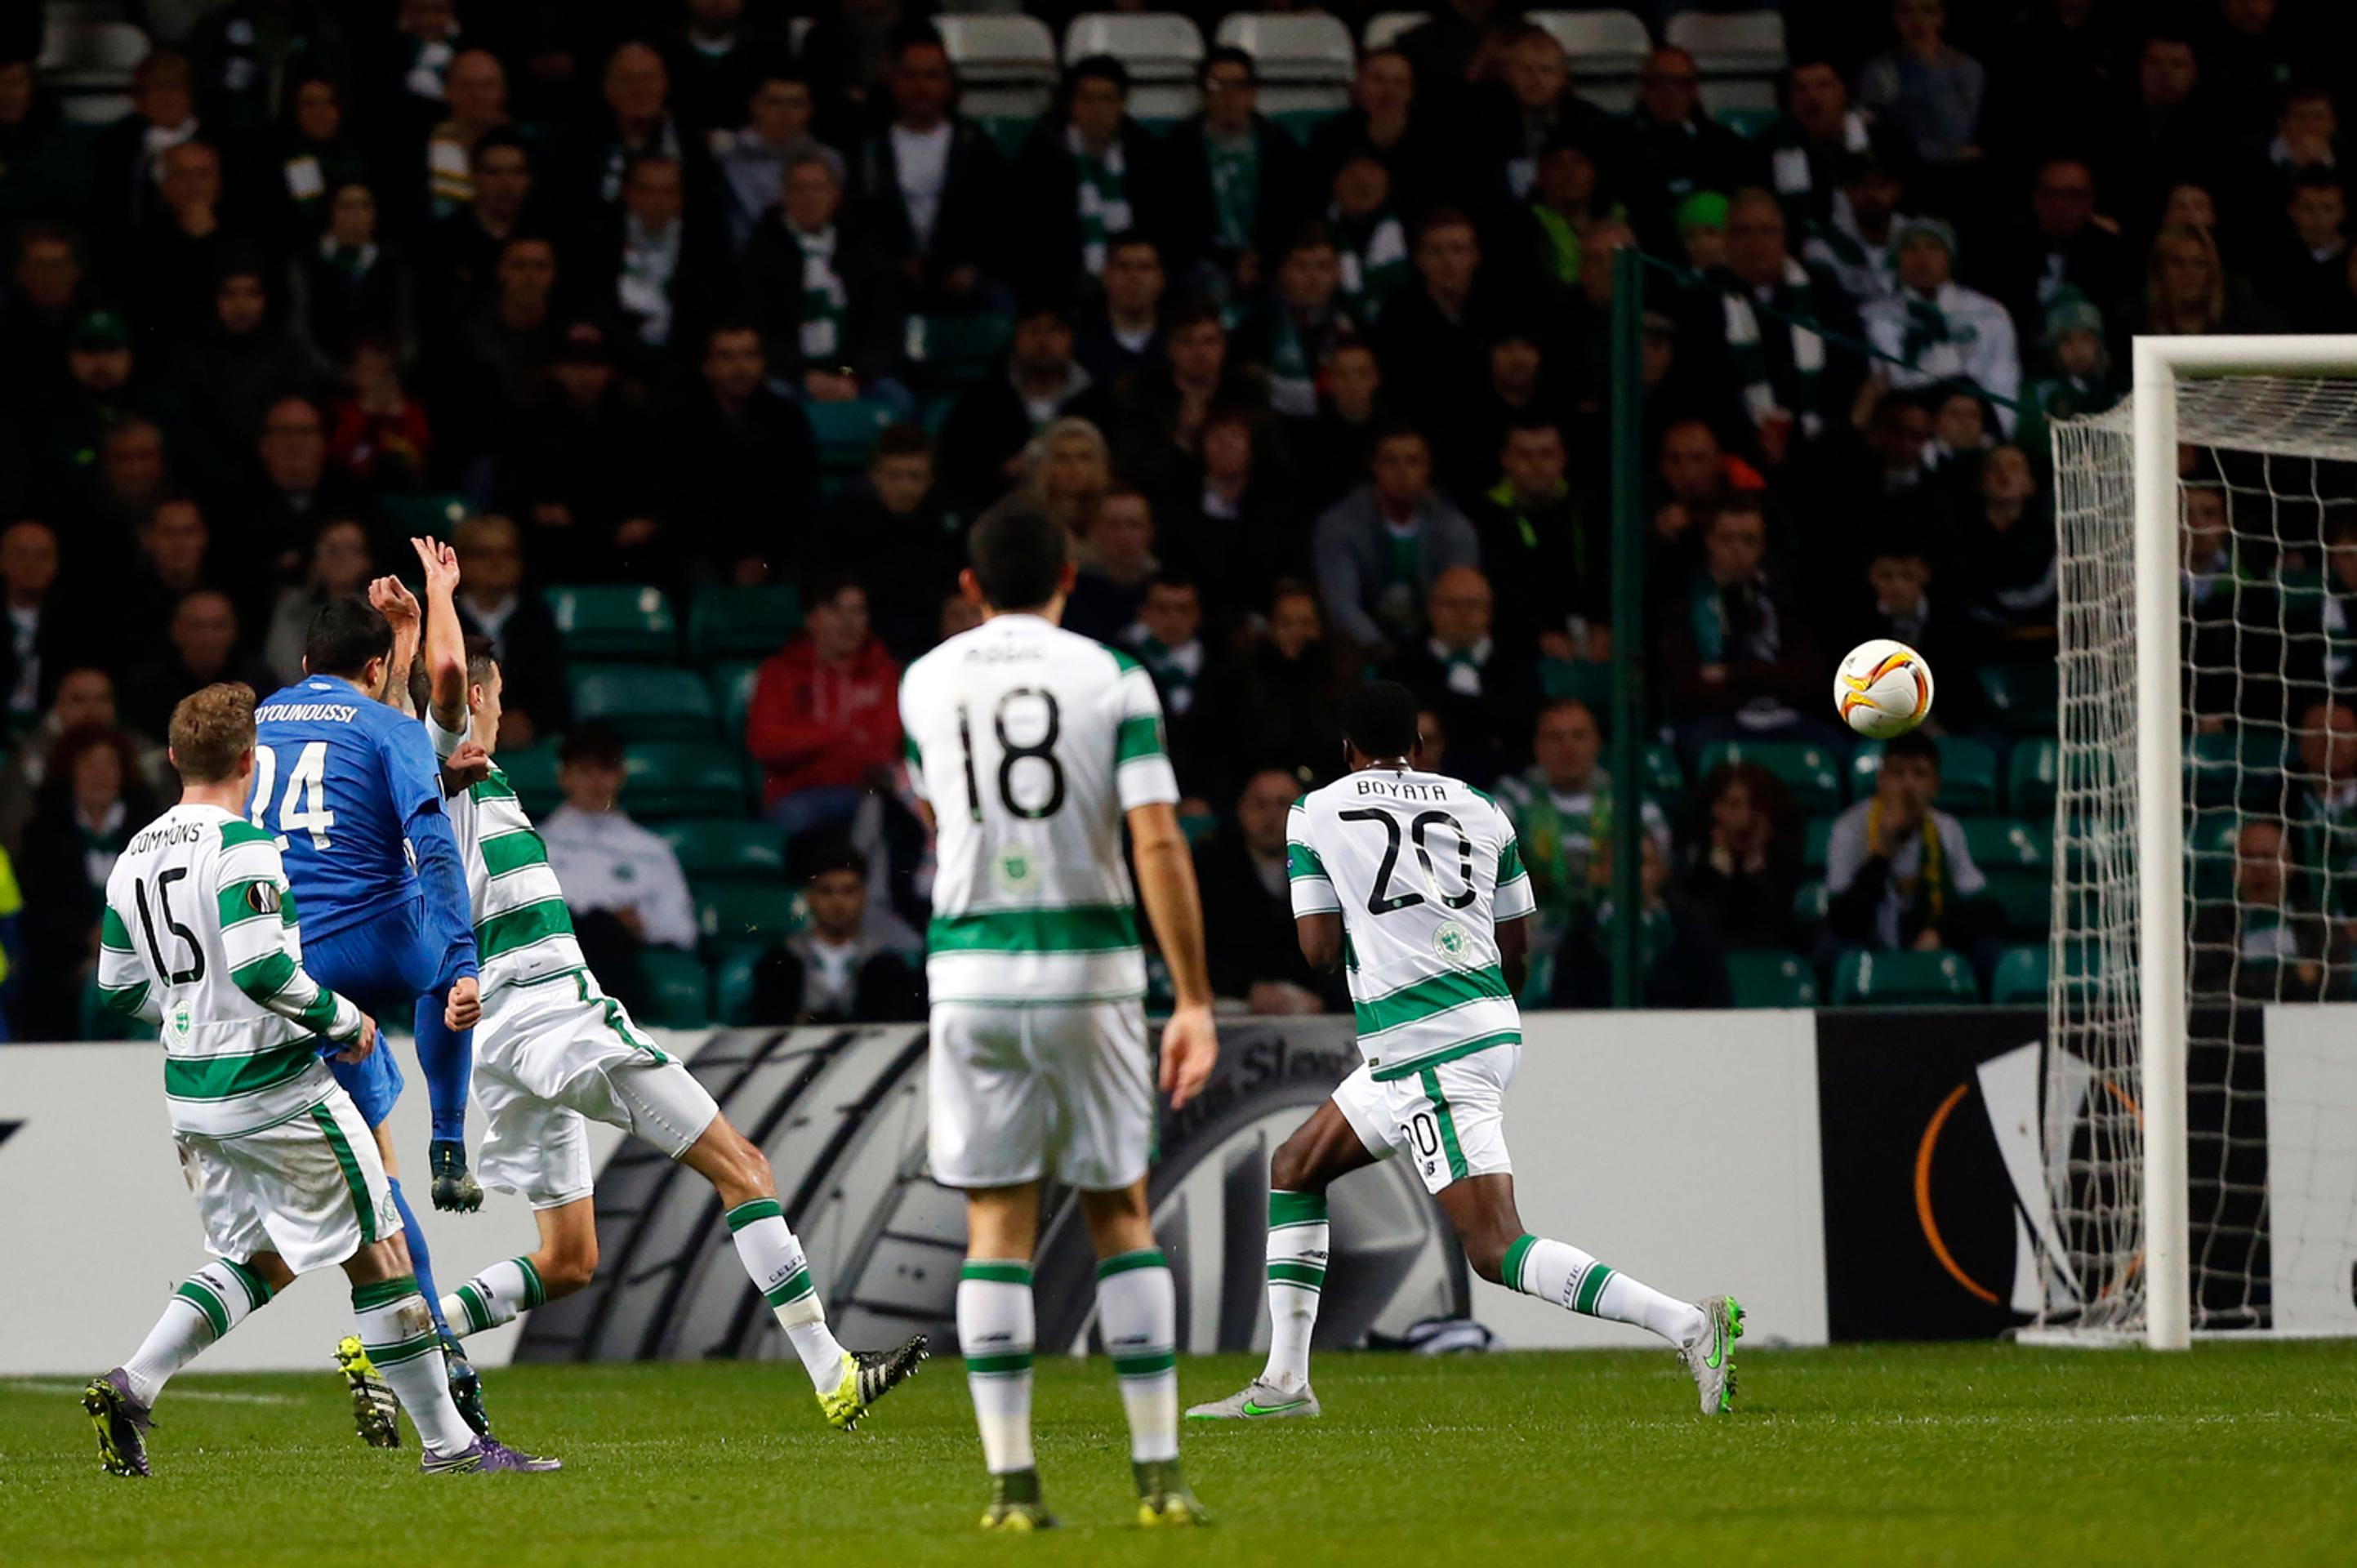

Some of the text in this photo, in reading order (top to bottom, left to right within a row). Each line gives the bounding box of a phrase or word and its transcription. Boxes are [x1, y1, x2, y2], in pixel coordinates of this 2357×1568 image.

[251, 742, 334, 851] 24
[957, 686, 1065, 823] 18
[1357, 781, 1448, 801] BOYATA
[130, 823, 203, 856] COMMONS
[1339, 808, 1477, 915] 20
[136, 867, 206, 987] 15
